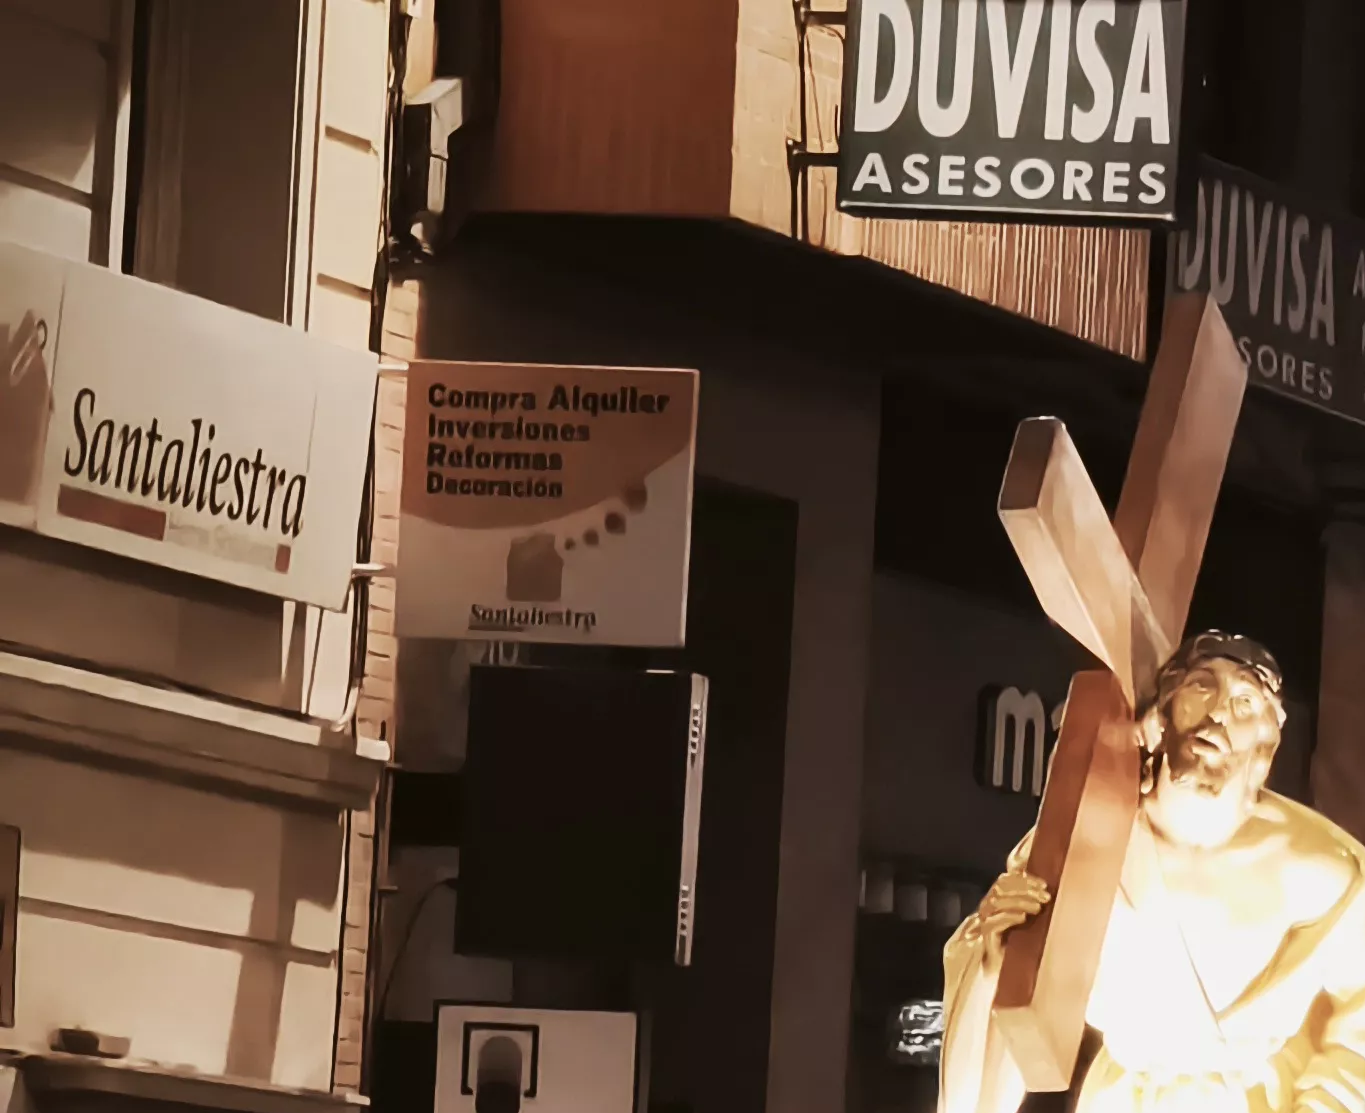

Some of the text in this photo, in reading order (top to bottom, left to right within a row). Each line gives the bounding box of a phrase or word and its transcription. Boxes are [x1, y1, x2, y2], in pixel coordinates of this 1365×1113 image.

[854, 0, 1170, 144] DUVISA
[852, 152, 1166, 204] ASESORES
[1237, 336, 1333, 401] SORES
[428, 382, 671, 419] Compra Alquiler
[428, 413, 591, 442] Inversiones
[64, 387, 305, 540] Santaliestra
[426, 442, 563, 471] Reformas
